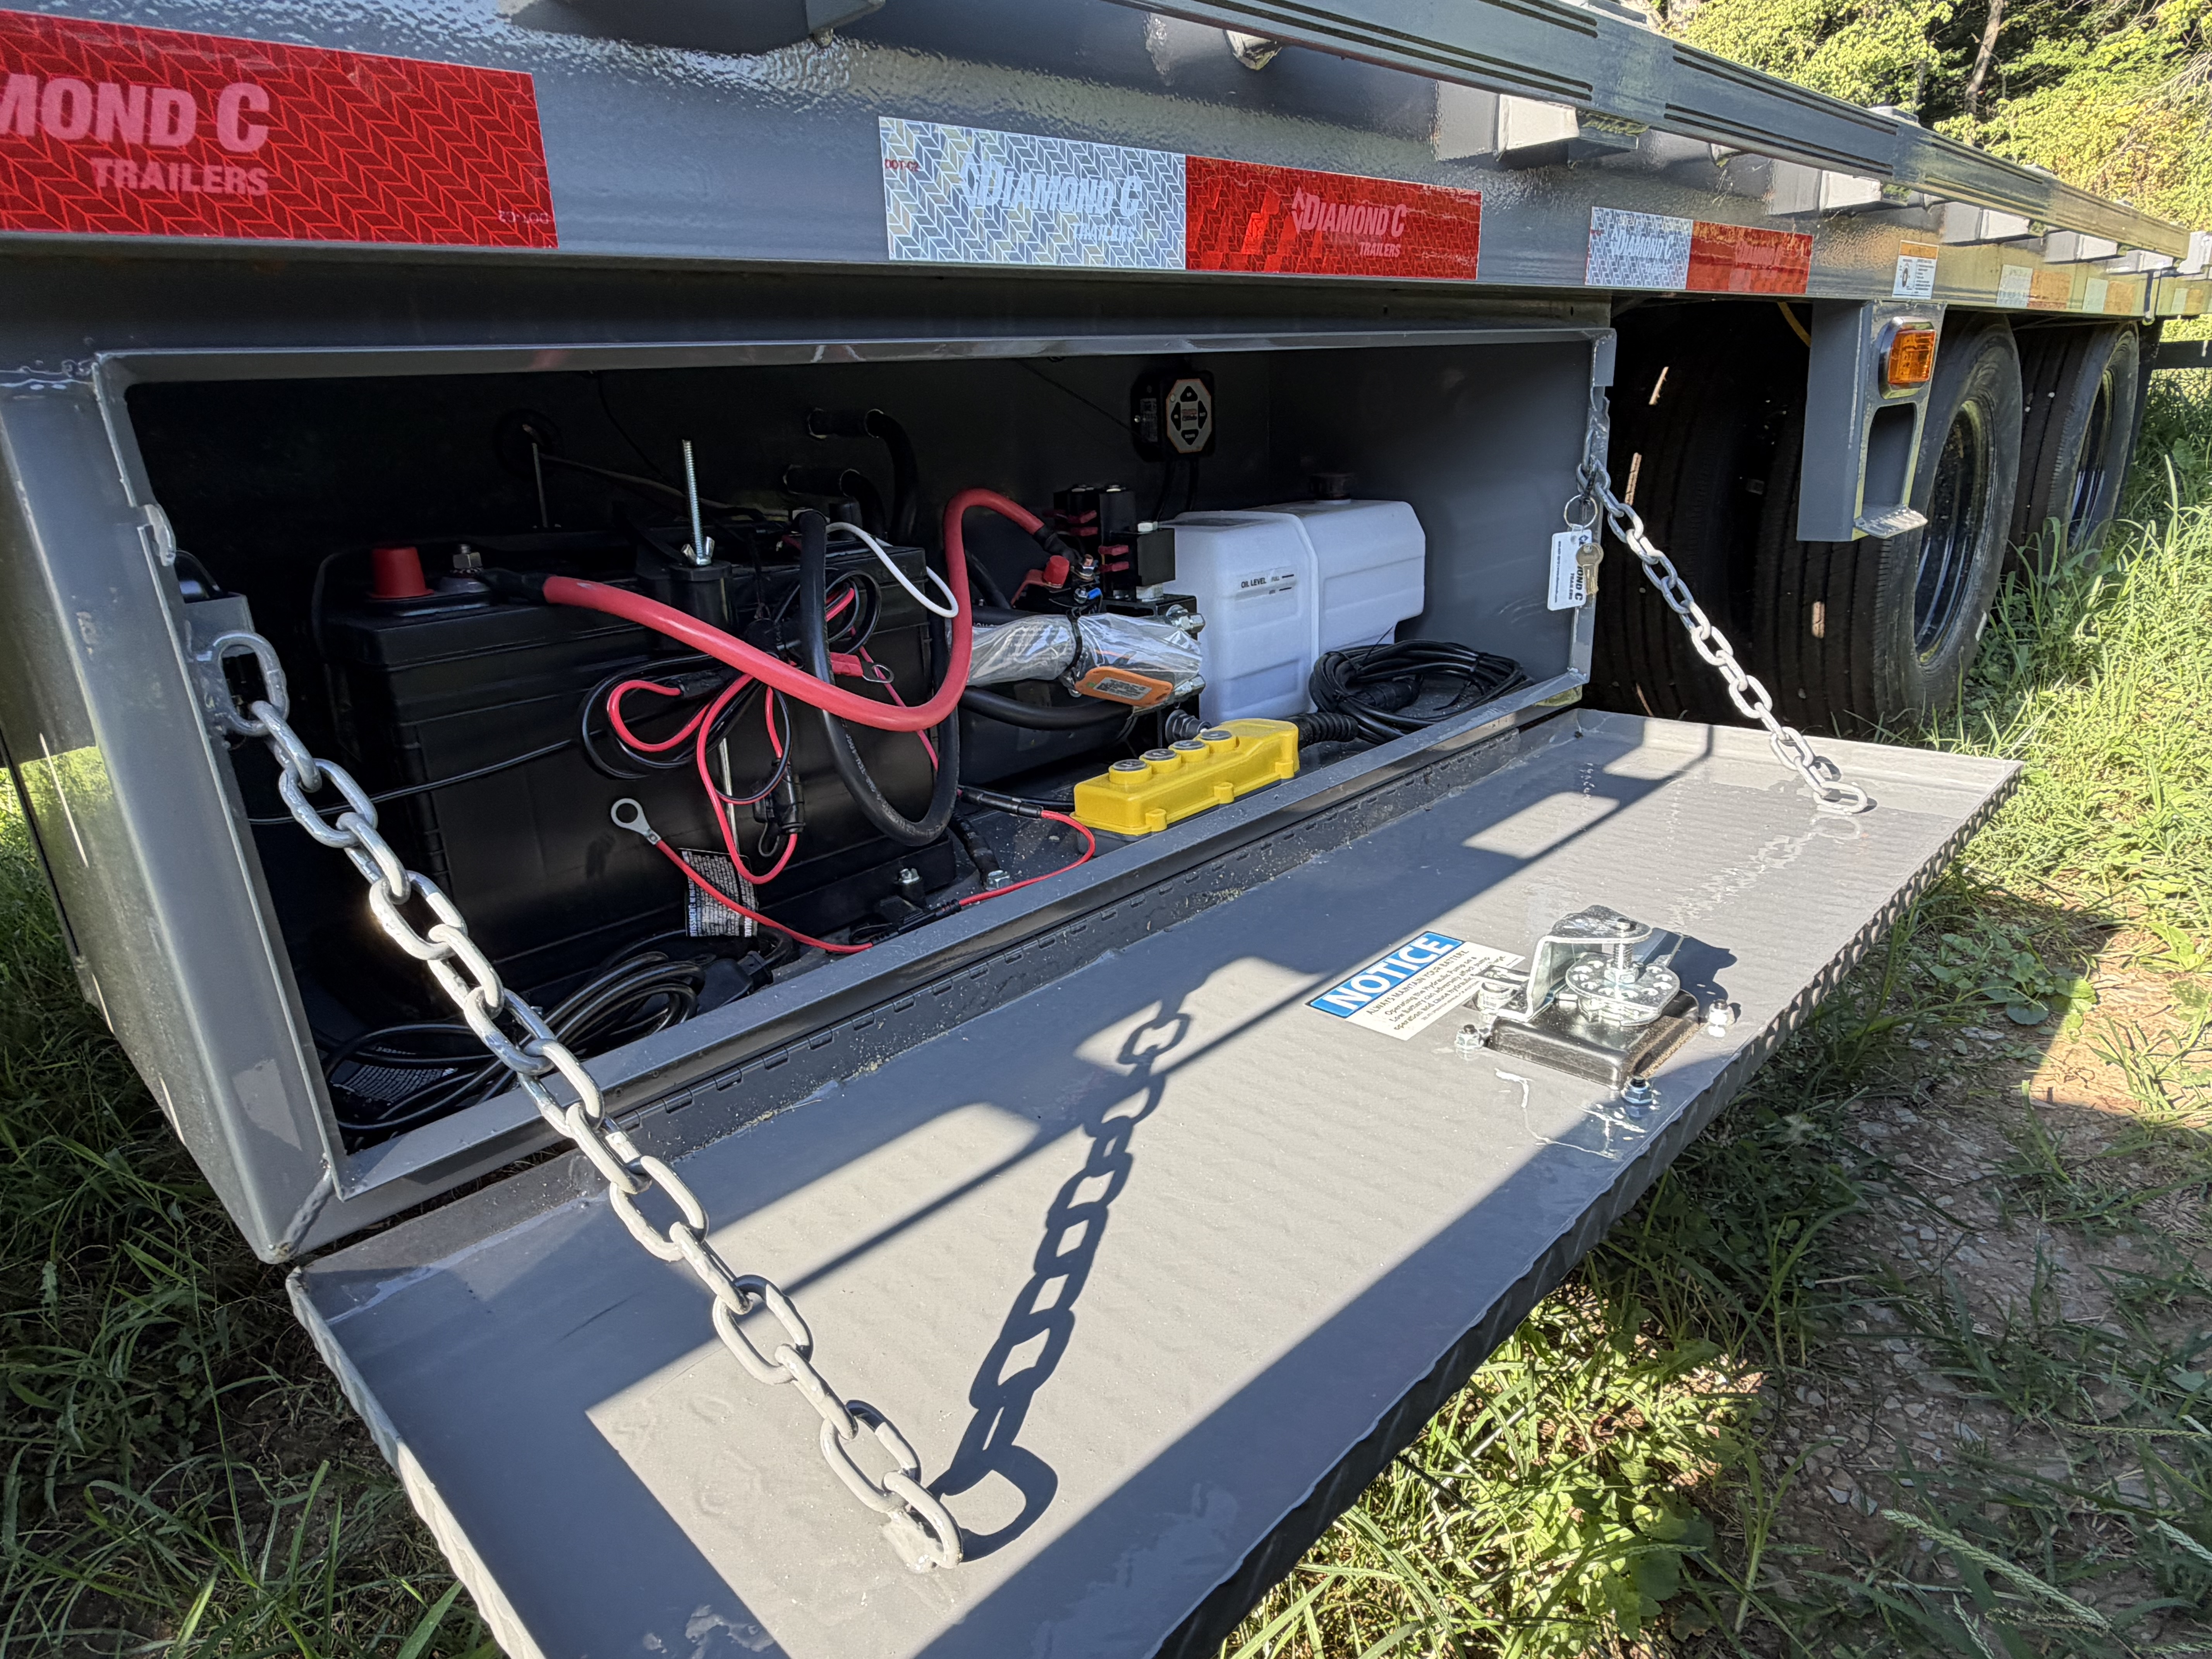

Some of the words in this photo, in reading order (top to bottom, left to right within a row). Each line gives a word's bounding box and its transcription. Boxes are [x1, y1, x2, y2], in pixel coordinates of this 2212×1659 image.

[0, 74, 197, 146] MOND
[217, 82, 270, 152] C
[91, 157, 269, 196] TRAILERS
[884, 158, 920, 172] DOT-C2
[977, 160, 1114, 215] DIAMOND
[1120, 175, 1142, 216] C
[1072, 223, 1135, 242] TRAILERS
[1301, 193, 1392, 236] DIAMOND
[1391, 203, 1407, 237] C
[1359, 242, 1401, 257] TRAILERS
[1250, 577, 1267, 586] LEVEL
[1322, 937, 1453, 1010] NOTICE
[1366, 997, 1395, 1015] ALWAYS
[1391, 977, 1426, 997] MAINTAIN
[1422, 966, 1442, 977] YOUR
